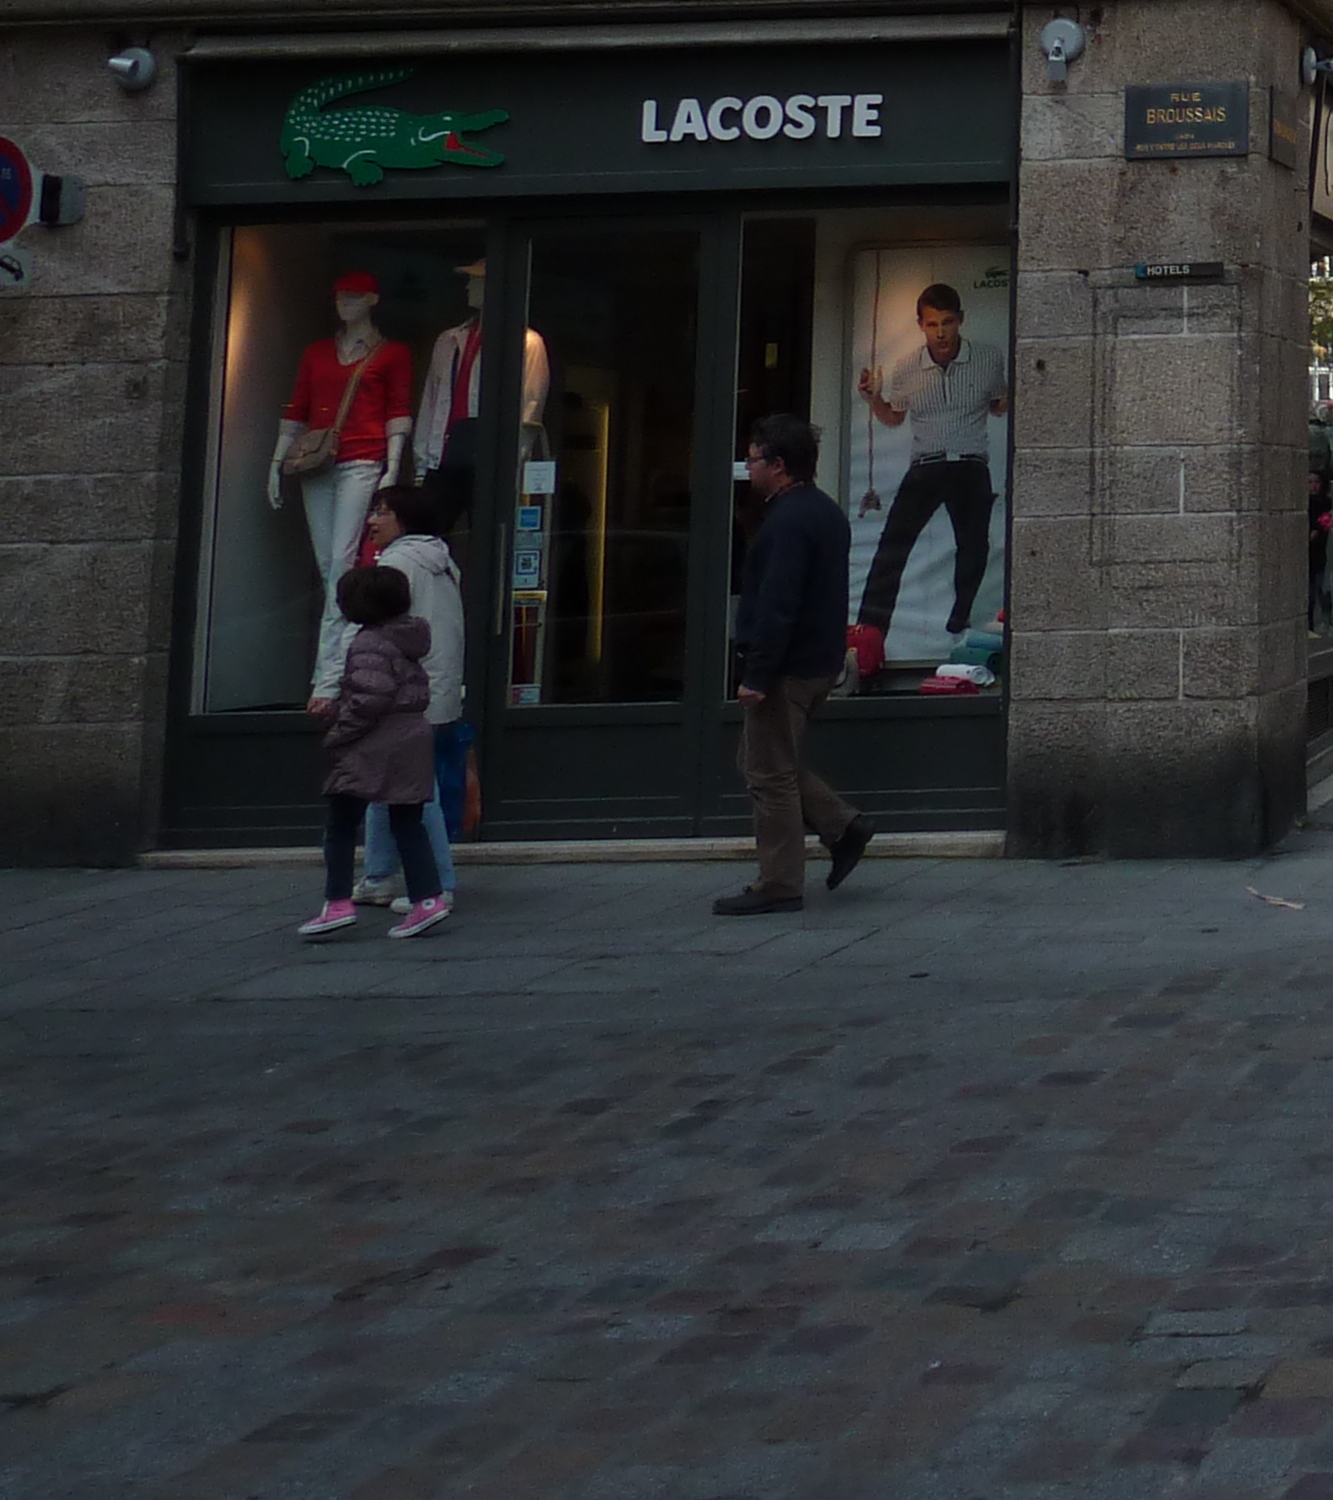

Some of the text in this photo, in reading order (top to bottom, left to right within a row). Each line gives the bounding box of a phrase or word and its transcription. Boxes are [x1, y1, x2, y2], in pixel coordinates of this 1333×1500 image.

[1170, 92, 1202, 102] RUE
[641, 94, 883, 143] LACOSTE
[1146, 106, 1227, 125] BROUSSAIS
[1146, 264, 1191, 276] HOTELS
[973, 278, 1009, 289] LACOS
